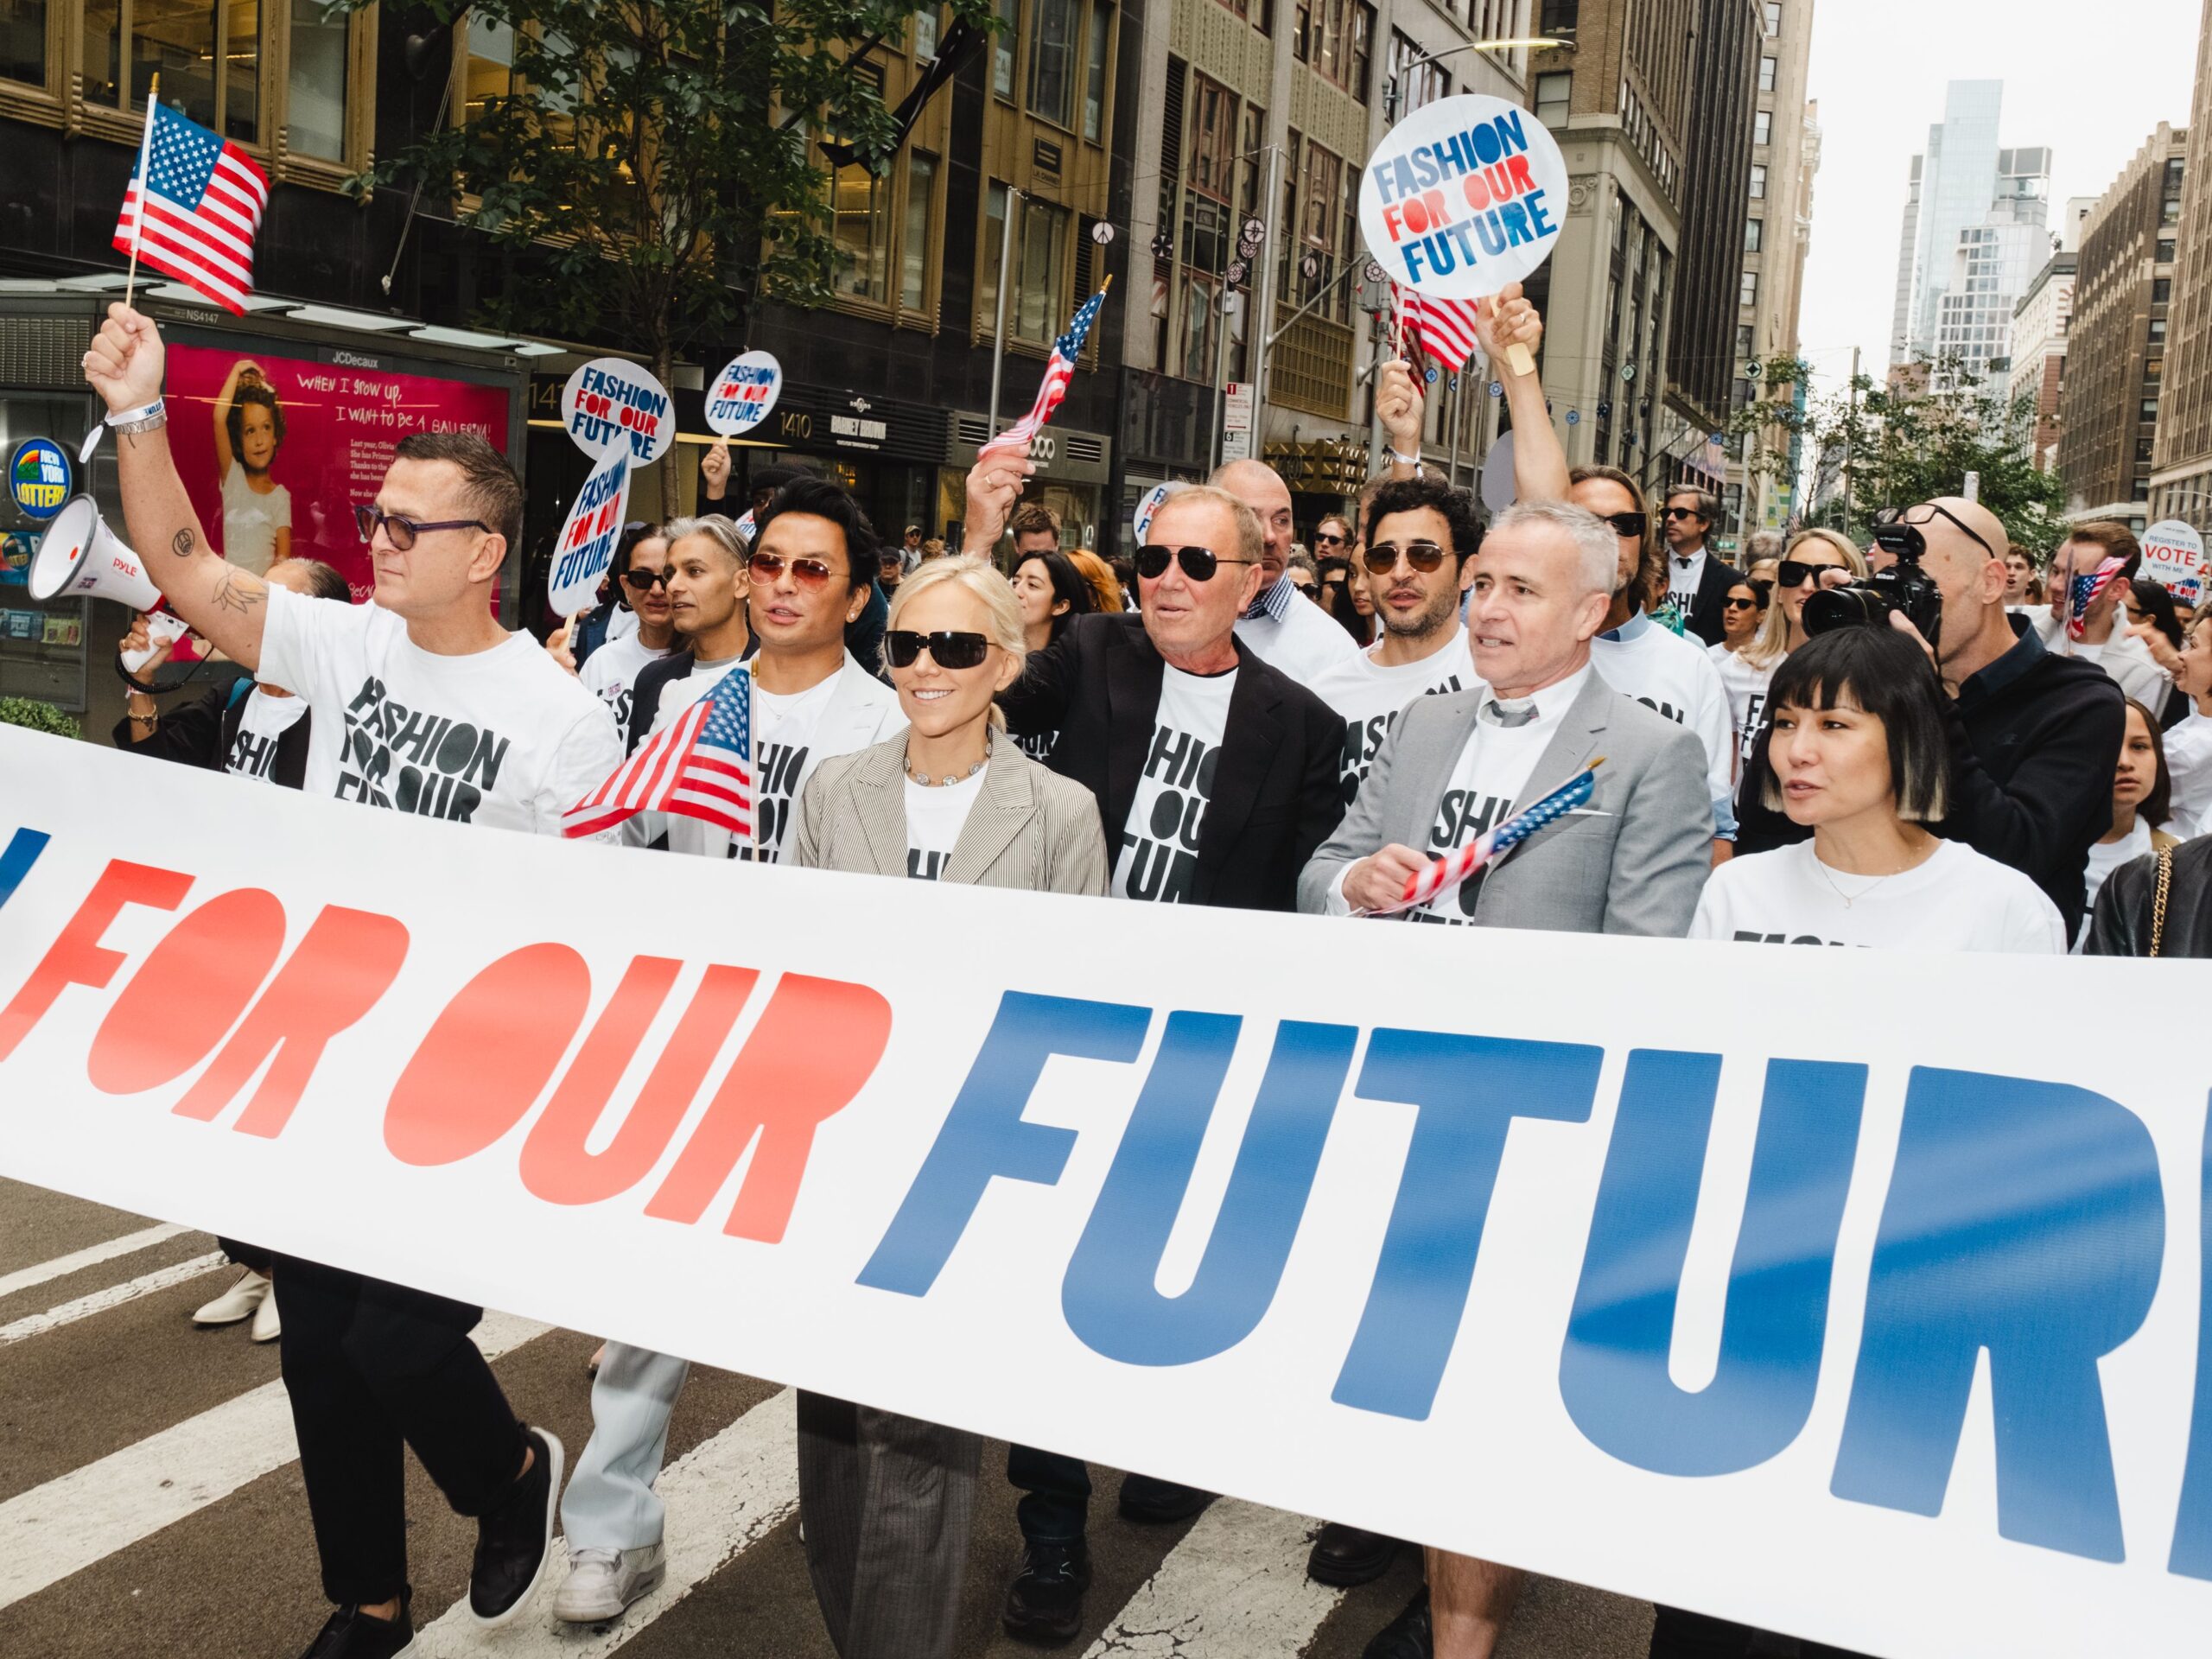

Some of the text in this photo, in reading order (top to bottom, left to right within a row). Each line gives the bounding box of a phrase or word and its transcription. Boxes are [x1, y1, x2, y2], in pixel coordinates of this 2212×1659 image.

[1372, 109, 1529, 205] FASHION
[1382, 154, 1536, 243] FOR OUR
[1400, 188, 1558, 284] FUTURE
[186, 308, 219, 324] NS4147
[333, 351, 378, 369] JCDecaux
[296, 373, 336, 392] WHEN
[340, 378, 349, 393] I
[724, 365, 778, 385] FASHION
[581, 366, 667, 418] FASHION
[715, 383, 768, 402] FOR OUR
[335, 406, 346, 422] I
[416, 415, 425, 431] A
[575, 389, 658, 436] FOR OUR
[709, 400, 764, 423] FUTURE
[781, 411, 811, 439] 1410
[350, 449, 395, 462] She has Primary
[351, 439, 363, 448] Last
[41, 448, 60, 467] NEW
[350, 461, 370, 470] Thanks
[378, 462, 388, 471] the
[41, 463, 65, 484] YORK
[350, 472, 359, 480] she
[359, 473, 370, 481] has
[16, 482, 67, 508] LOTTERY
[350, 488, 373, 498] Now she
[563, 491, 621, 551] FOR OUR
[2149, 535, 2186, 547] REGISTER
[552, 524, 617, 592] FUTURE
[2145, 543, 2197, 567] VOTE
[2152, 563, 2171, 571] WITH
[2179, 587, 2196, 598] OUR
[347, 675, 512, 791] FASHION
[1143, 724, 1222, 801] HIO
[396, 765, 482, 823] OUR
[1149, 790, 1210, 851] OU
[1431, 789, 1514, 849] SHI
[0, 858, 410, 1140] FOR
[383, 942, 893, 1245] OUR
